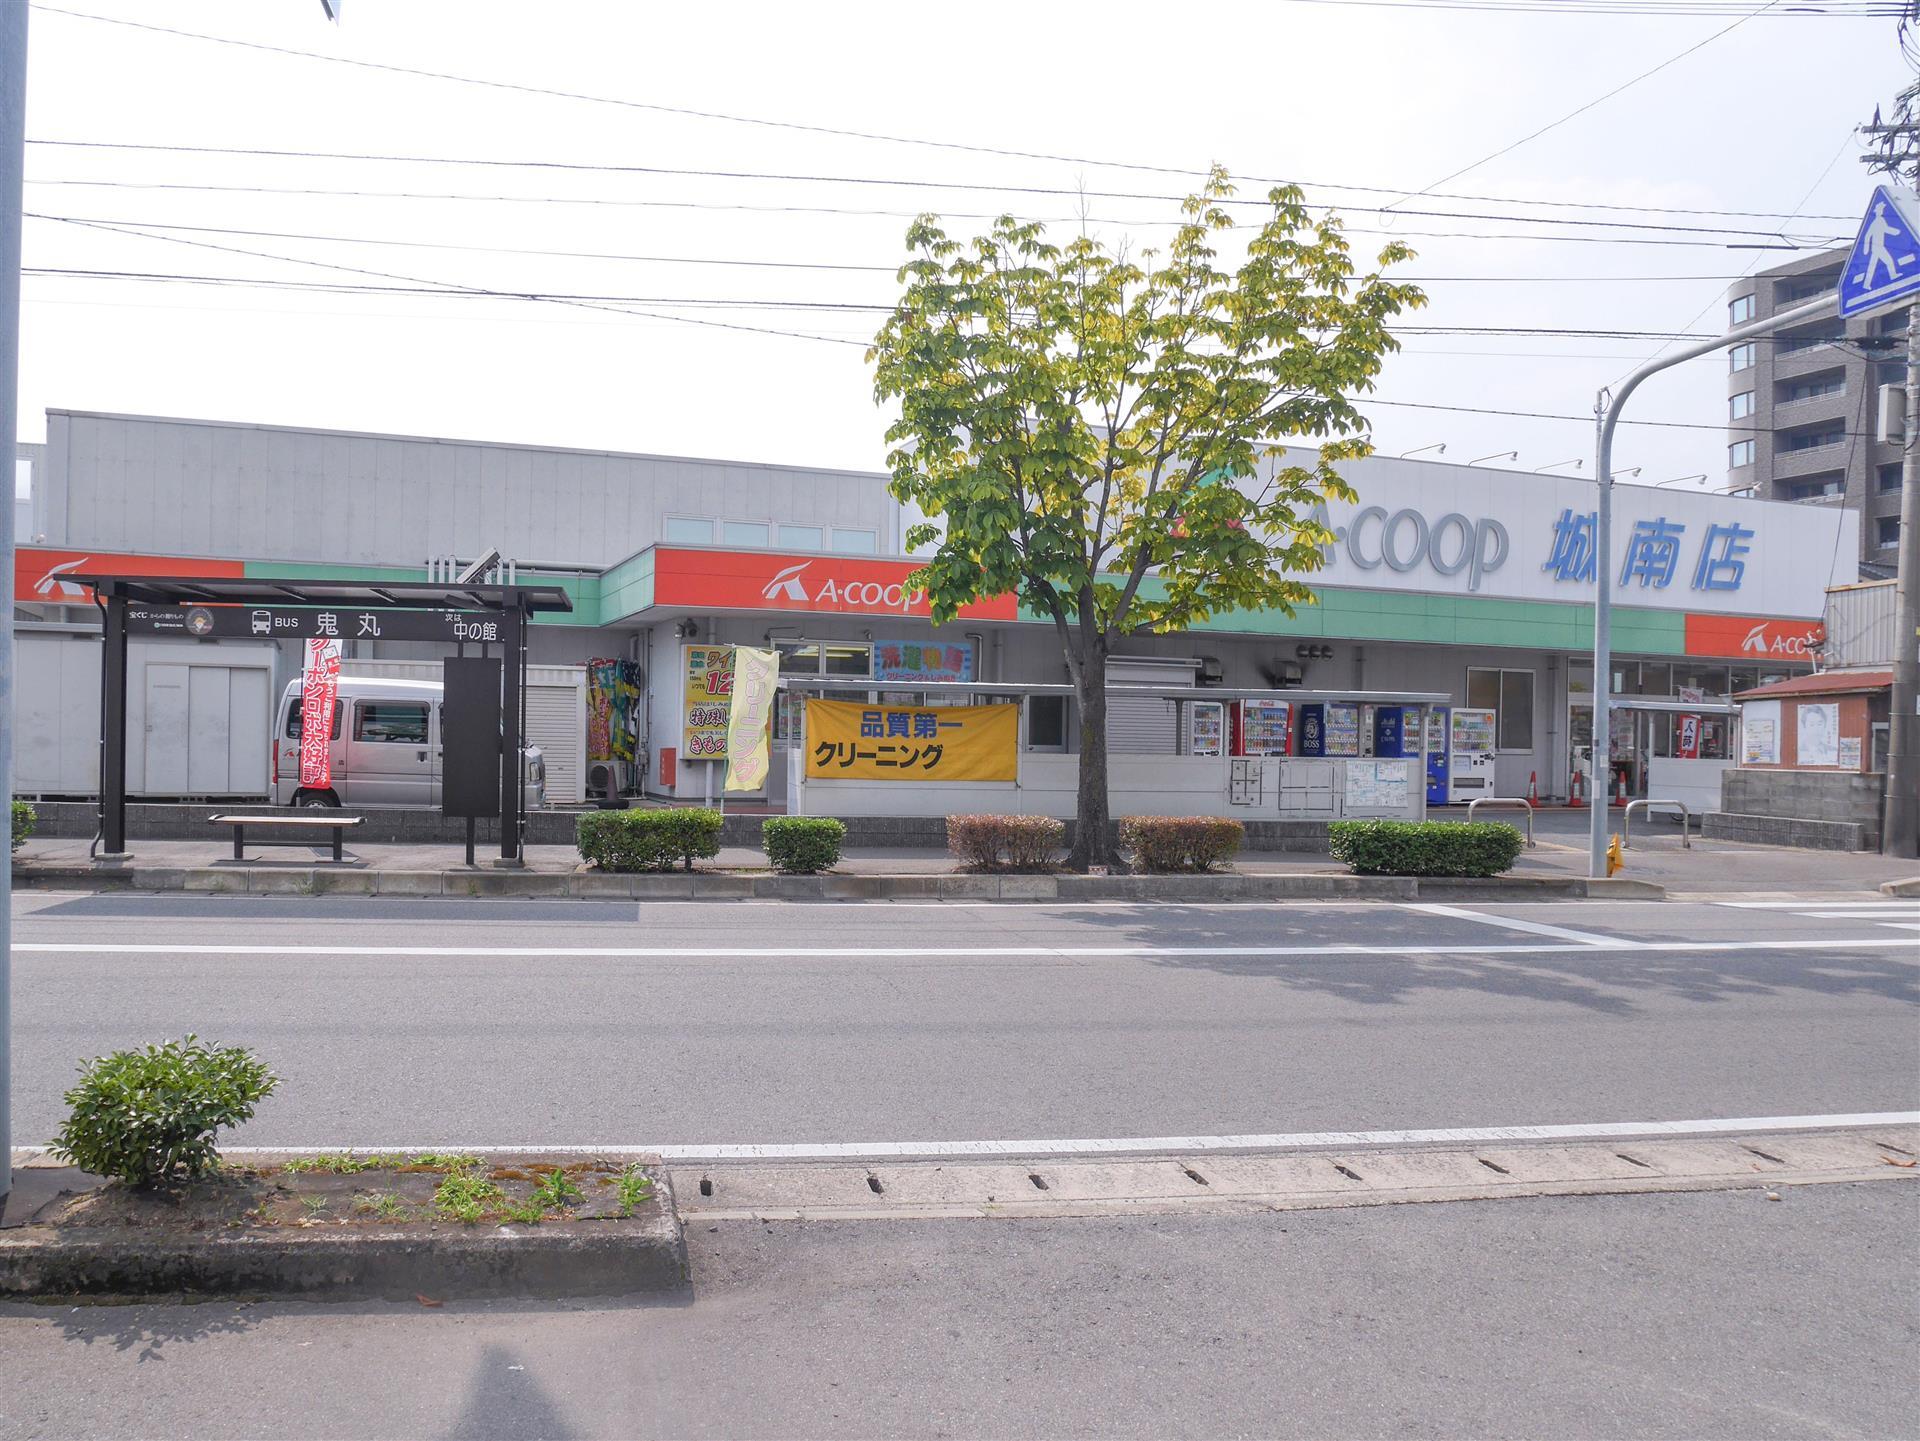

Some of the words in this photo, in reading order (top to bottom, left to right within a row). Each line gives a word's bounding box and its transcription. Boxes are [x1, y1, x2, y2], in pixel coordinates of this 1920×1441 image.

[1541, 508, 1756, 591] 城南店
[274, 617, 299, 628] BUS
[315, 611, 381, 636] 鬼丸
[445, 613, 462, 622] 次は
[454, 620, 498, 641] 中の館
[735, 658, 769, 783] クリーニング
[860, 711, 963, 739] 品質第一
[1303, 739, 1320, 749] BOSS
[1682, 720, 1694, 748] 入荷
[814, 741, 944, 770] クリーニング
